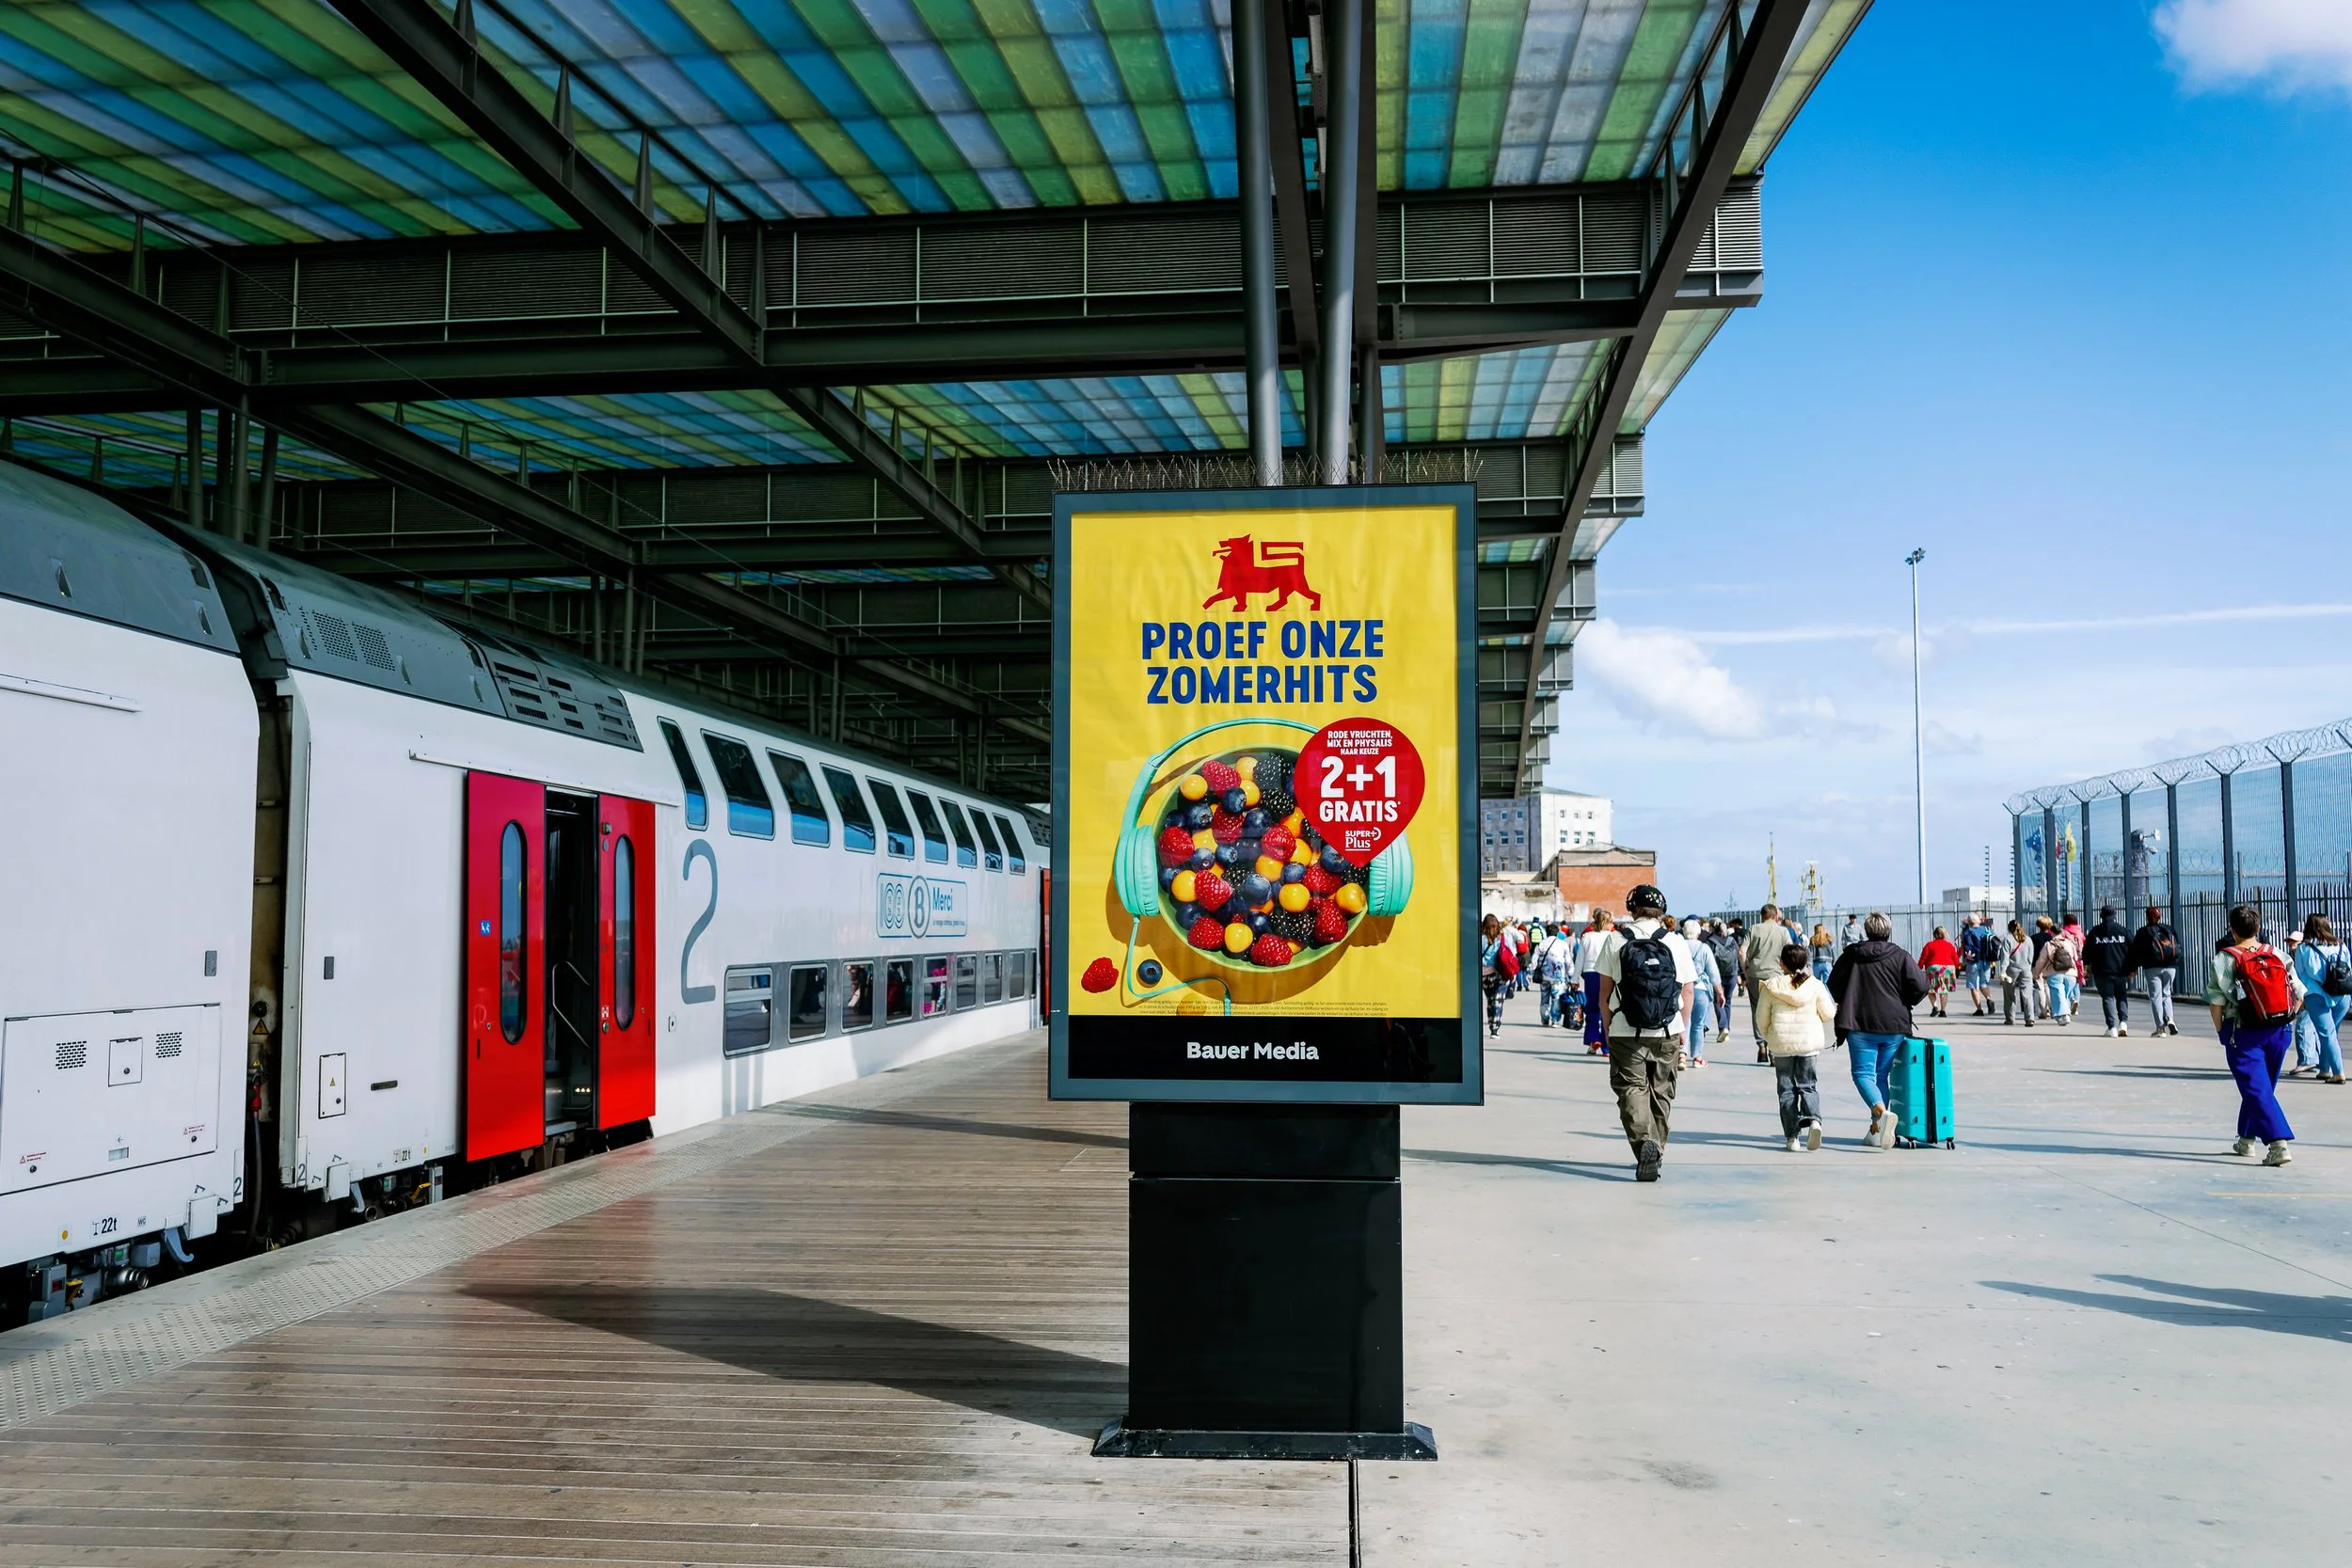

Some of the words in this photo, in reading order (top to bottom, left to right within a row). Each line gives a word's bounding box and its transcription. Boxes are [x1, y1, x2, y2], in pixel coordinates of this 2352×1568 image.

[1142, 621, 1267, 659] PROEF
[1280, 619, 1384, 657] ONZE
[1146, 664, 1378, 704] ZOMERHITS
[1327, 730, 1348, 739] RODE
[1350, 730, 1393, 739] VRUCHTEN,
[1327, 739, 1342, 748] MIX
[1355, 738, 1393, 747] PHYSALIS
[1320, 755, 1396, 799] 2+1
[1345, 837, 1372, 848] Plus
[933, 887, 953, 911] Merci
[680, 839, 719, 1005] 2
[1186, 1041, 1249, 1059] Bauer
[1254, 1041, 1319, 1060] Media
[297, 1164, 306, 1181] 2
[233, 1177, 242, 1196] 2
